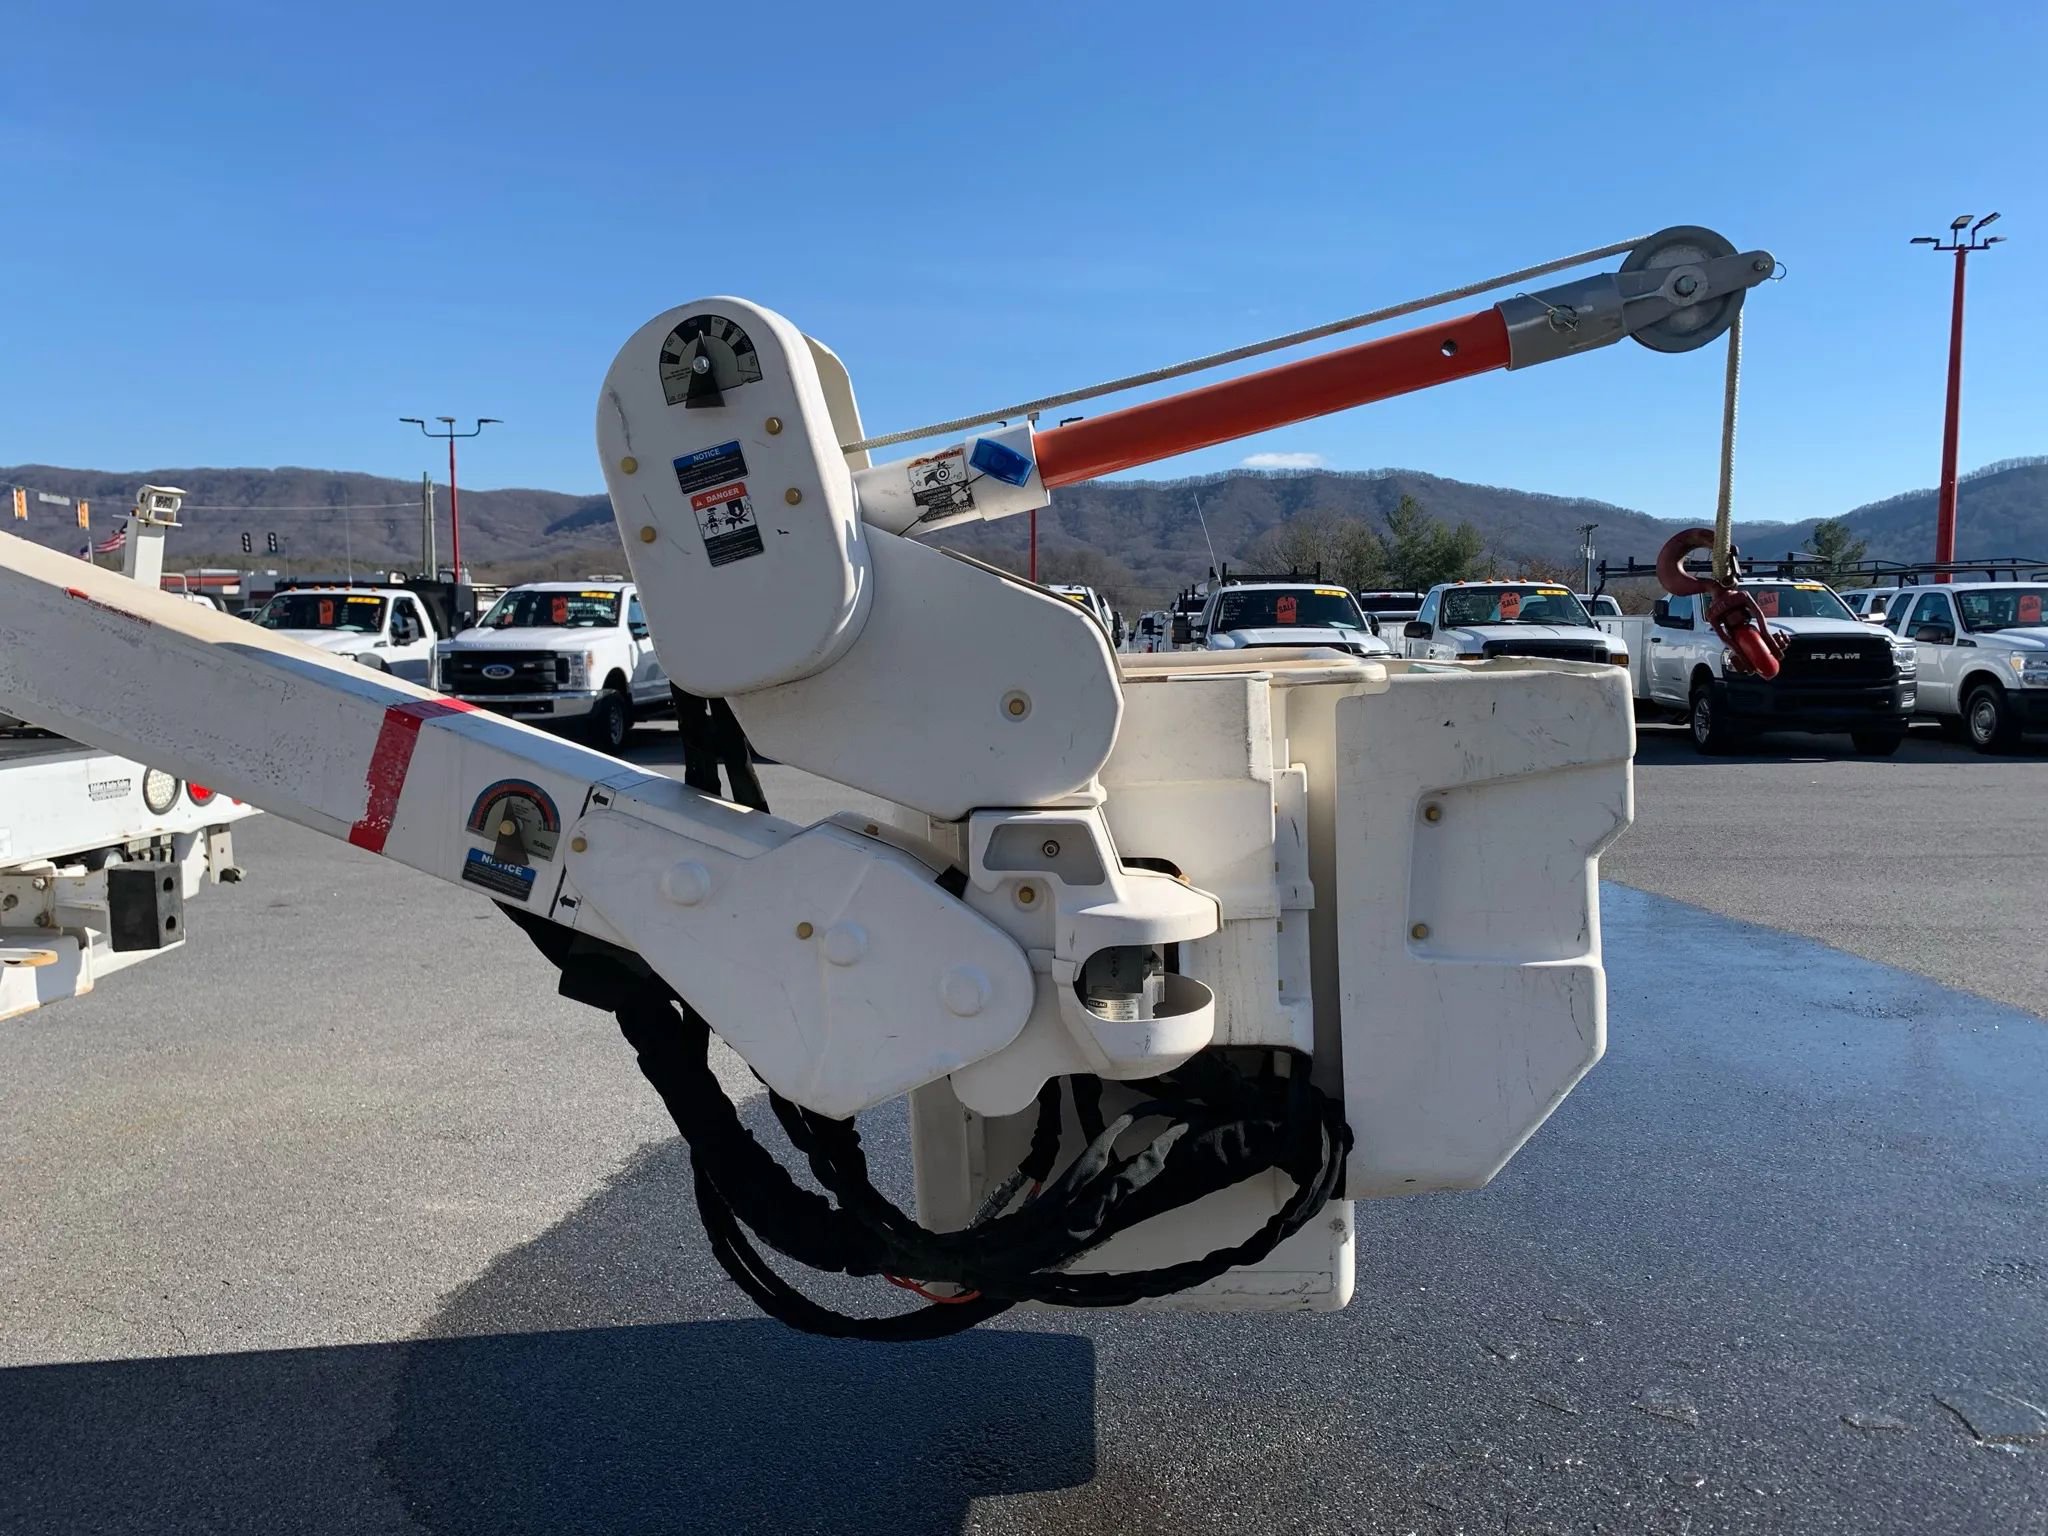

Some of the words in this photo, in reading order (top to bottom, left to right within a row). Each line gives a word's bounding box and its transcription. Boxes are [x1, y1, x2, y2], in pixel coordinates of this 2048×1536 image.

[692, 448, 721, 462] NOTICE
[706, 487, 740, 503] DANGER
[1278, 602, 1295, 614] SALE
[1502, 598, 1519, 608] SALE
